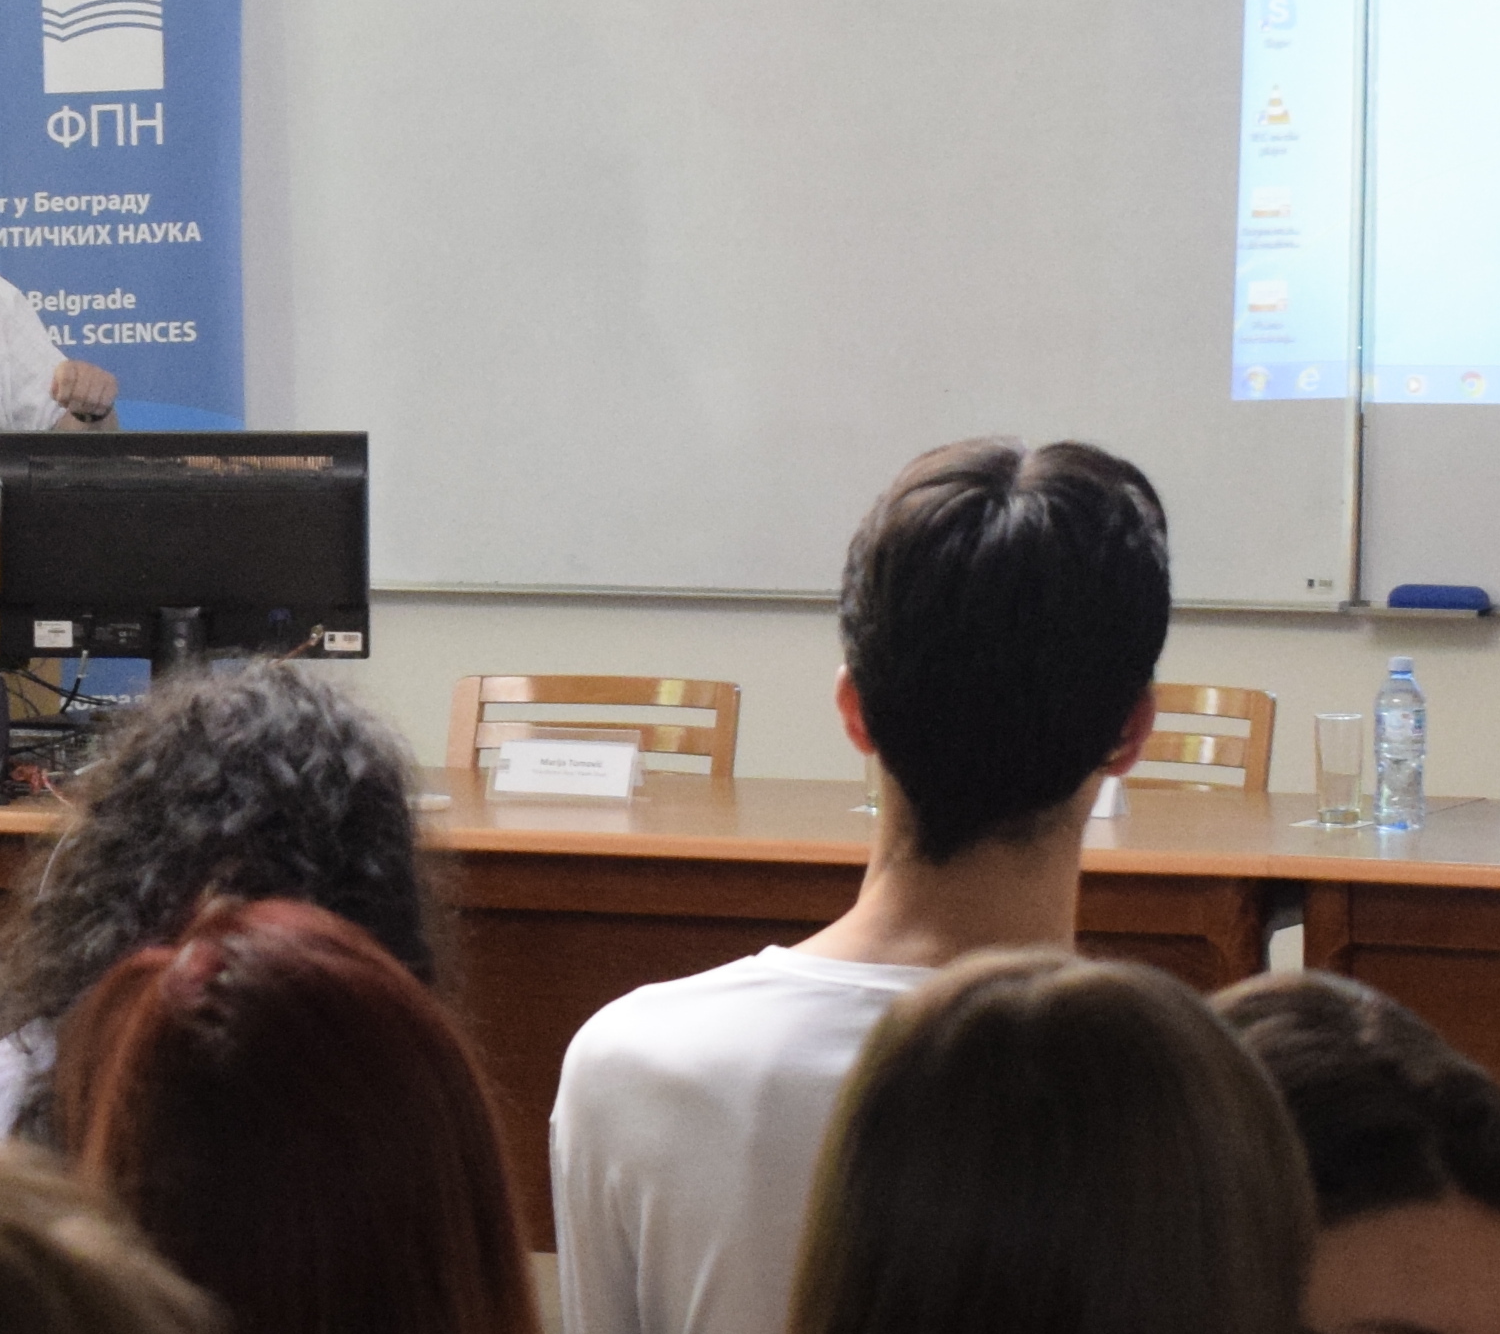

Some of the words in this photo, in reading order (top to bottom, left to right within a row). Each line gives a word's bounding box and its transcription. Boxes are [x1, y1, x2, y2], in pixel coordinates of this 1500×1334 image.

[46, 102, 164, 149] ФПН
[13, 197, 29, 219] у
[34, 191, 152, 217] Београду
[117, 221, 202, 245] НАУКА
[28, 287, 137, 316] Belgrade
[82, 321, 198, 345] SCIENCES
